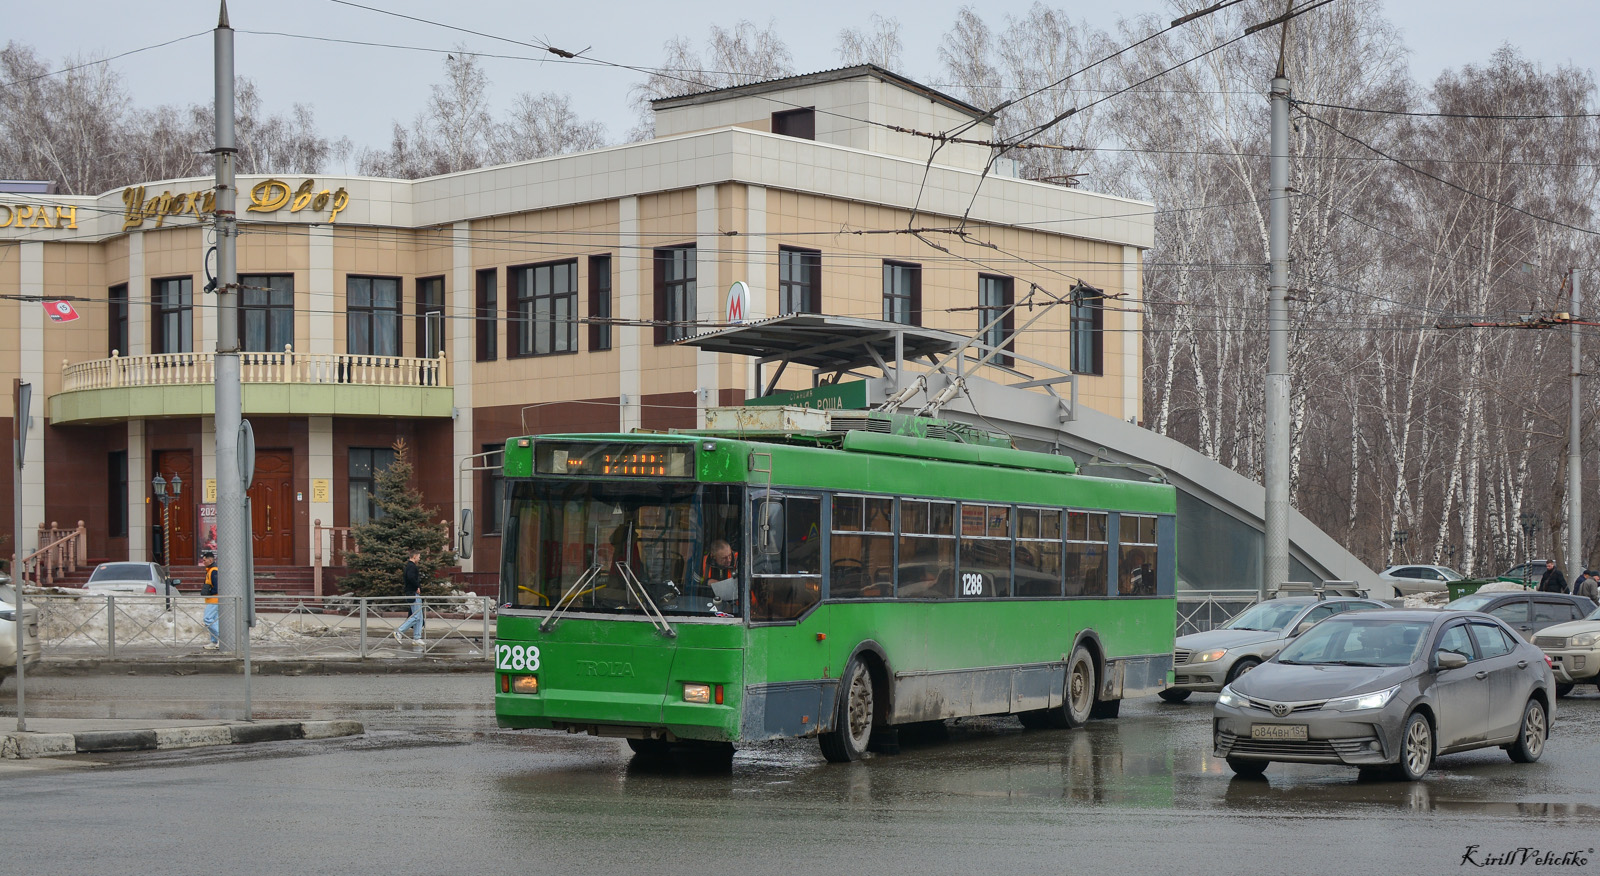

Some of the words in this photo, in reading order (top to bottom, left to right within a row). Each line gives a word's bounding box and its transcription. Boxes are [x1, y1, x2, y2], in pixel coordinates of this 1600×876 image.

[121, 185, 238, 231] Царски
[246, 178, 349, 223] Двор
[59, 304, 68, 312] 15
[200, 507, 217, 517] 202
[962, 573, 982, 596] 1288
[494, 644, 540, 671] 1288
[1290, 726, 1305, 735] 154
